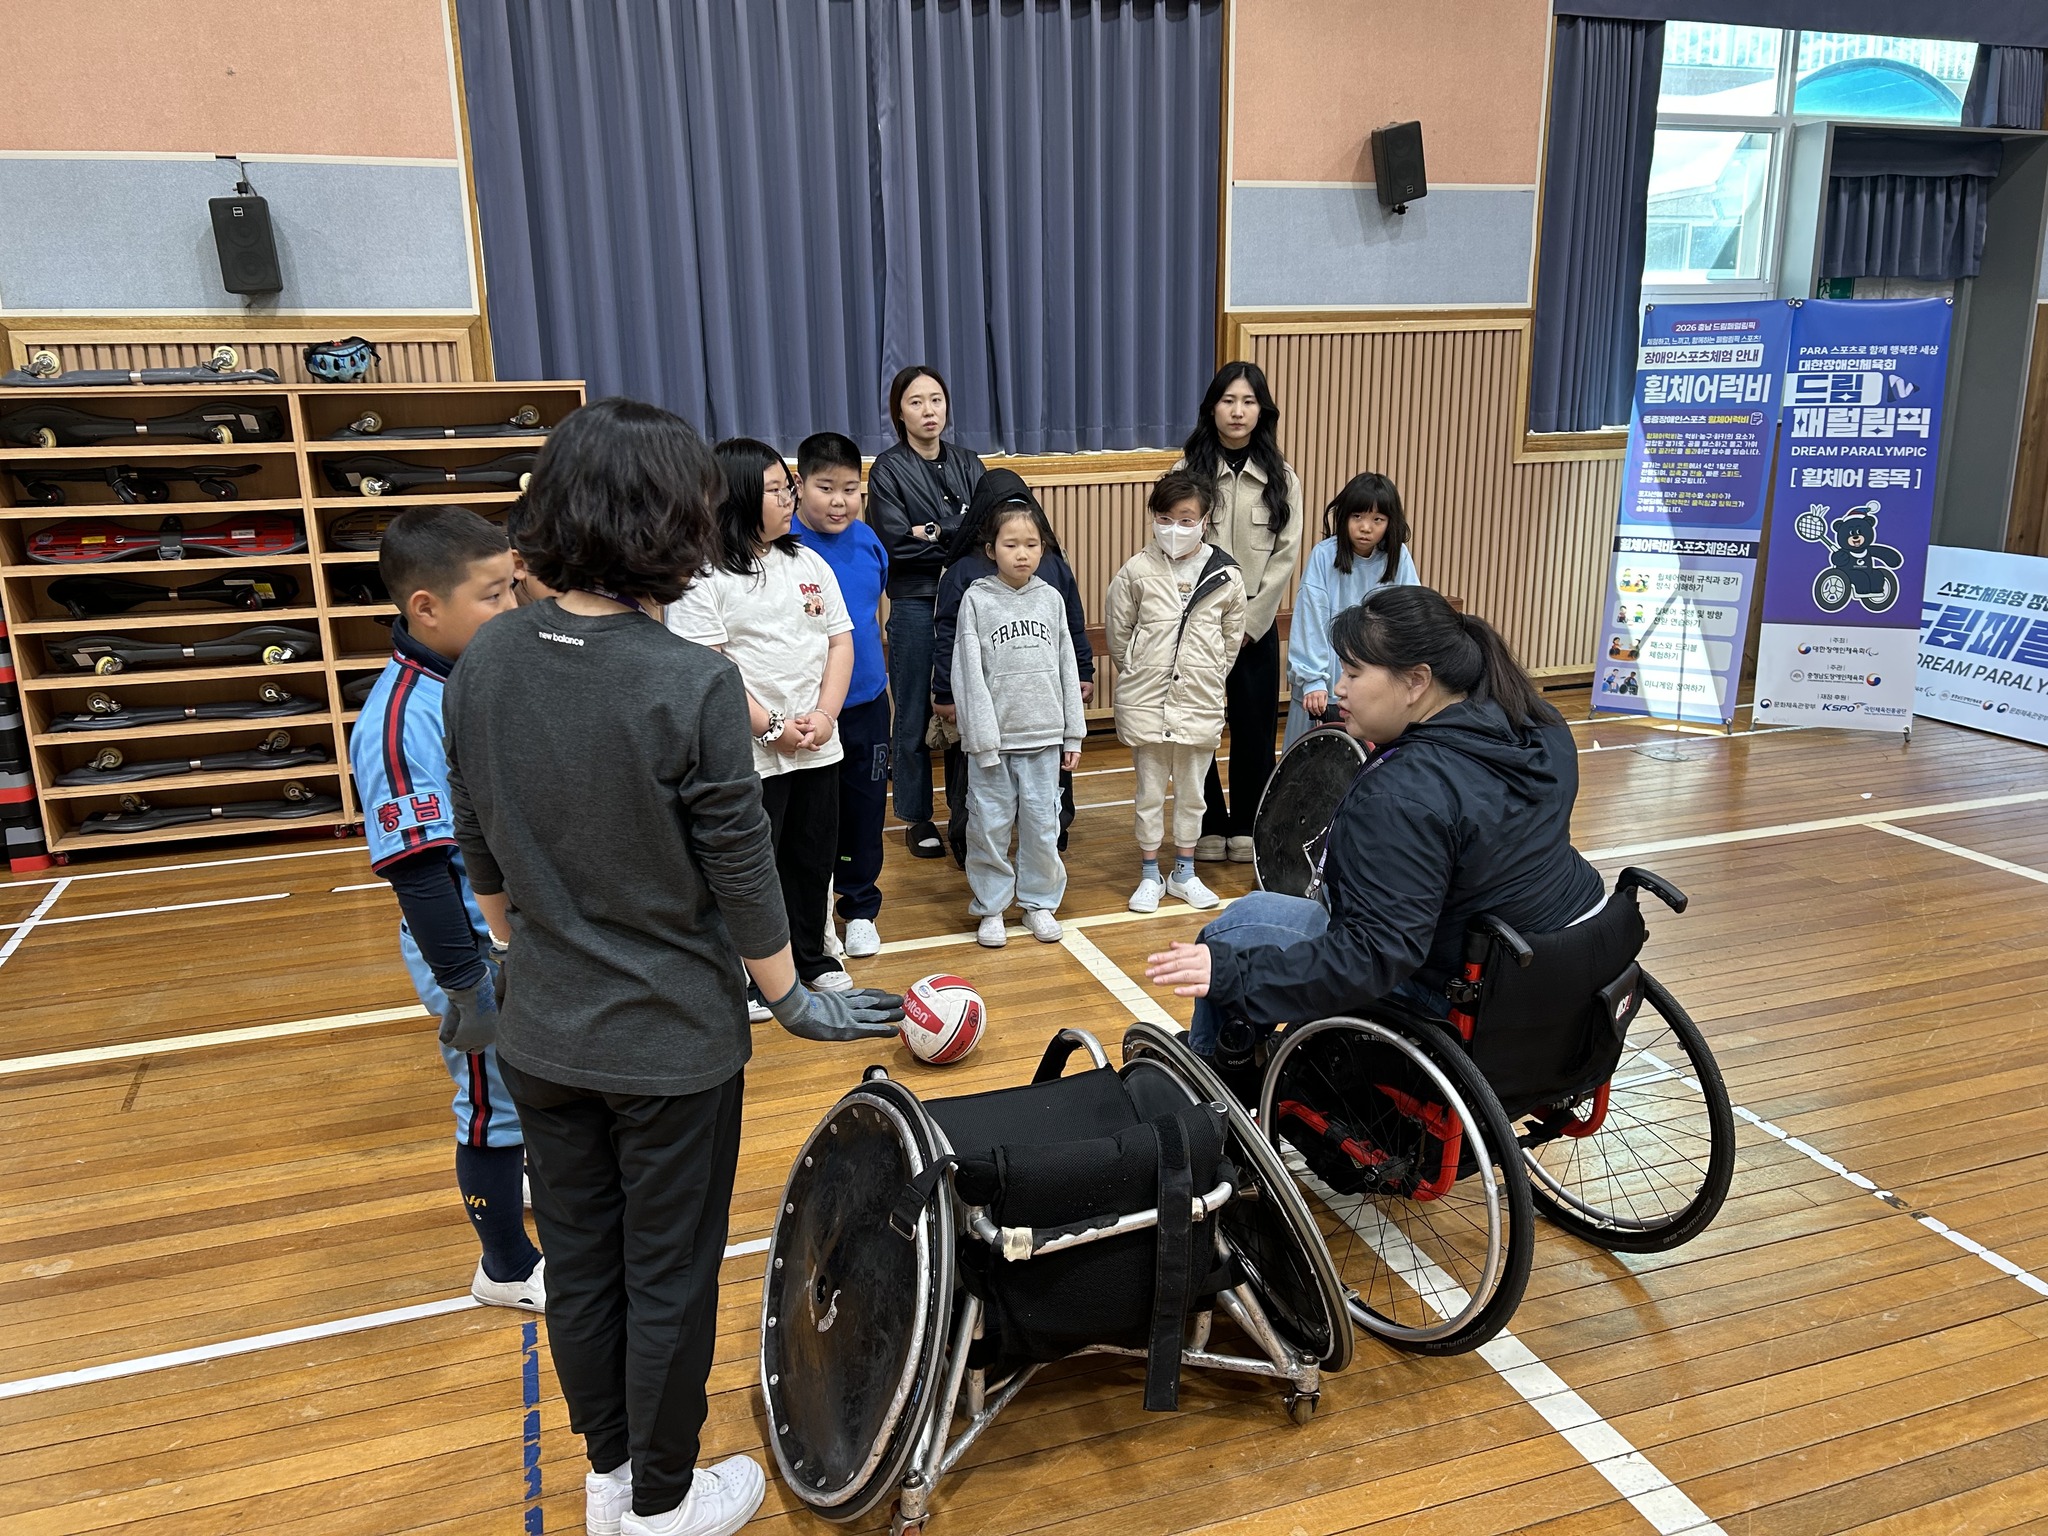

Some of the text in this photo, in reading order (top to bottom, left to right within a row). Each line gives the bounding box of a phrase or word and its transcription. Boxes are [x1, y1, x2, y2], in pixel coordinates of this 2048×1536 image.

[1675, 323, 1697, 332] 2026
[1698, 323, 1713, 331] 충남
[1799, 345, 1939, 355] PARA 스포츠로 함께 행복한 세상
[1644, 349, 1759, 365] 장애인스포츠체험 안내
[1798, 358, 1897, 371] 대한장애인체육회
[1644, 373, 1772, 404] 휠체어럭비
[1794, 373, 1864, 404] 드림
[1643, 415, 1749, 424] 중증장애인스포츠 휠체어럭비
[1790, 407, 1932, 438] 패럴림픽
[1791, 446, 1927, 457] DREAM PARALYMPIC
[1801, 467, 1911, 489] 휠체어 종목
[1619, 537, 1750, 557] 휠체어럭비스포츠체험순서
[1657, 573, 1739, 586] 휠체어럭비 규칙과 경기
[1673, 582, 1704, 592] 이해하기
[1937, 581, 2048, 612] 스포츠체험형 장
[1697, 609, 1705, 620] 및
[1706, 610, 1723, 620] 방향
[1670, 618, 1701, 628] 연습하기
[538, 631, 585, 647] new balance
[1650, 641, 1698, 652] 패스와 드리블
[1812, 645, 1866, 655] 대한장애인체육회
[1649, 651, 1679, 660] 체험하기
[1807, 672, 1865, 682] 충청남도장애인체육회
[1972, 664, 2048, 696] PARALY
[1644, 680, 1706, 693] 미니게임 참여하기
[1773, 701, 1816, 710] 문화체육관광부
[1822, 703, 1856, 713] KSPO
[1864, 706, 1907, 715] 국민체육진흥공단
